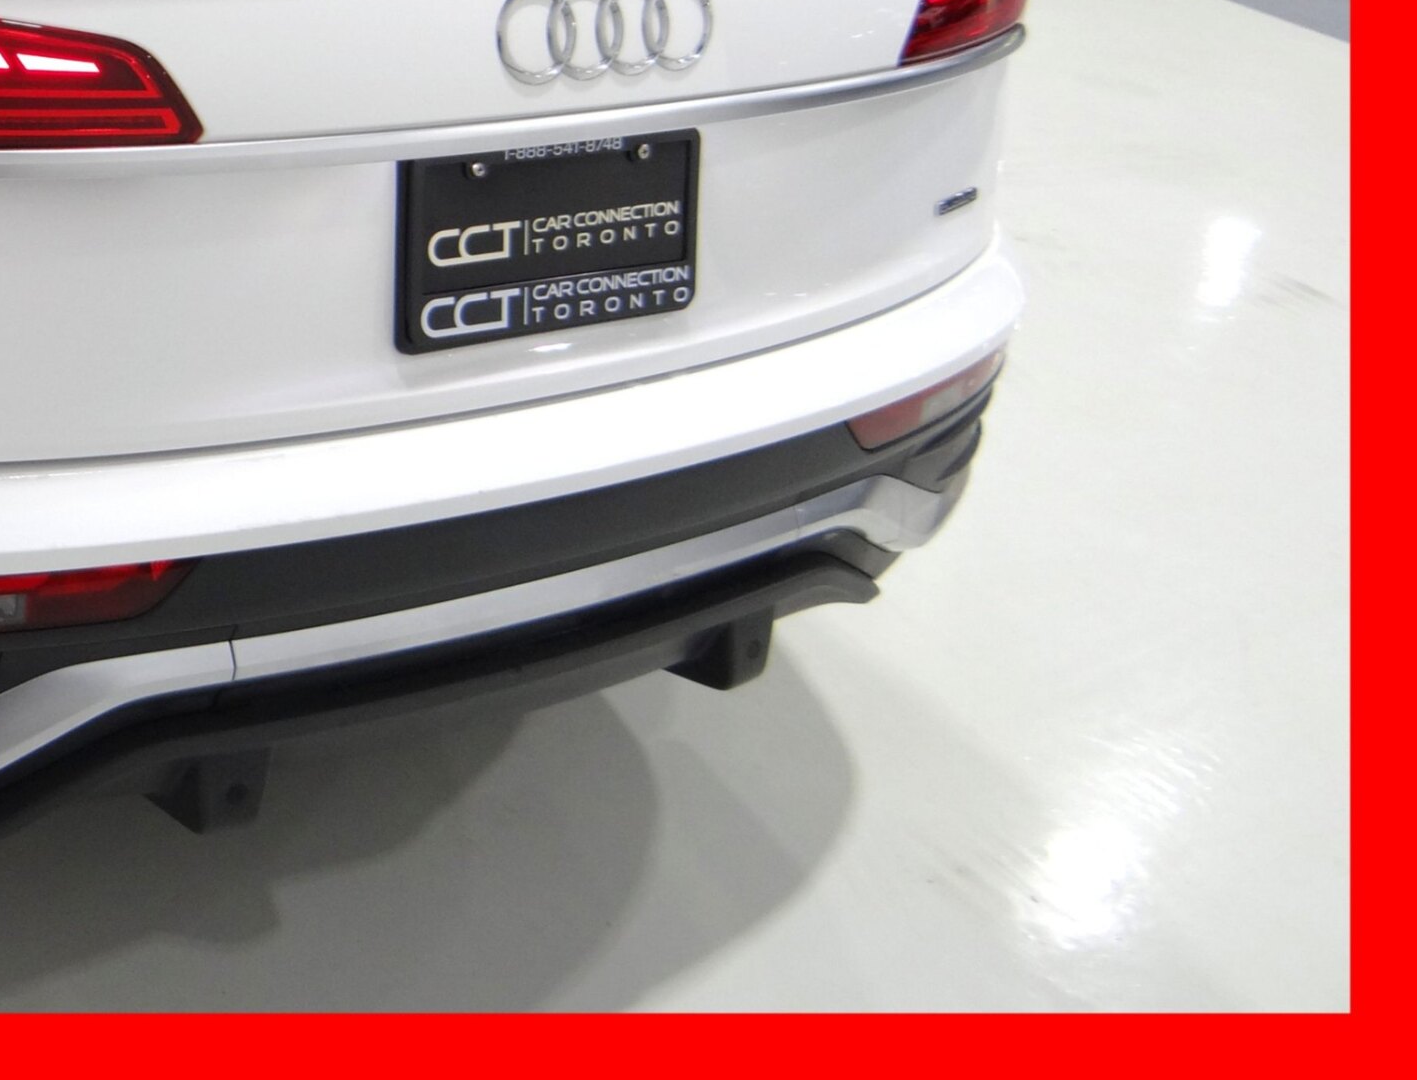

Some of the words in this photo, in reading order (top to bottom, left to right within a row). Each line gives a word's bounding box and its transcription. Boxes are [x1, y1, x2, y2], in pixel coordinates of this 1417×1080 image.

[532, 214, 571, 232] CAR
[573, 200, 680, 227] CONNECTION
[427, 220, 522, 267] CCT
[532, 220, 680, 253] TORONTO
[532, 281, 574, 300] CAR
[576, 265, 690, 294] CONNECTION
[420, 288, 521, 338] CCT
[532, 287, 690, 323] TORONTO
